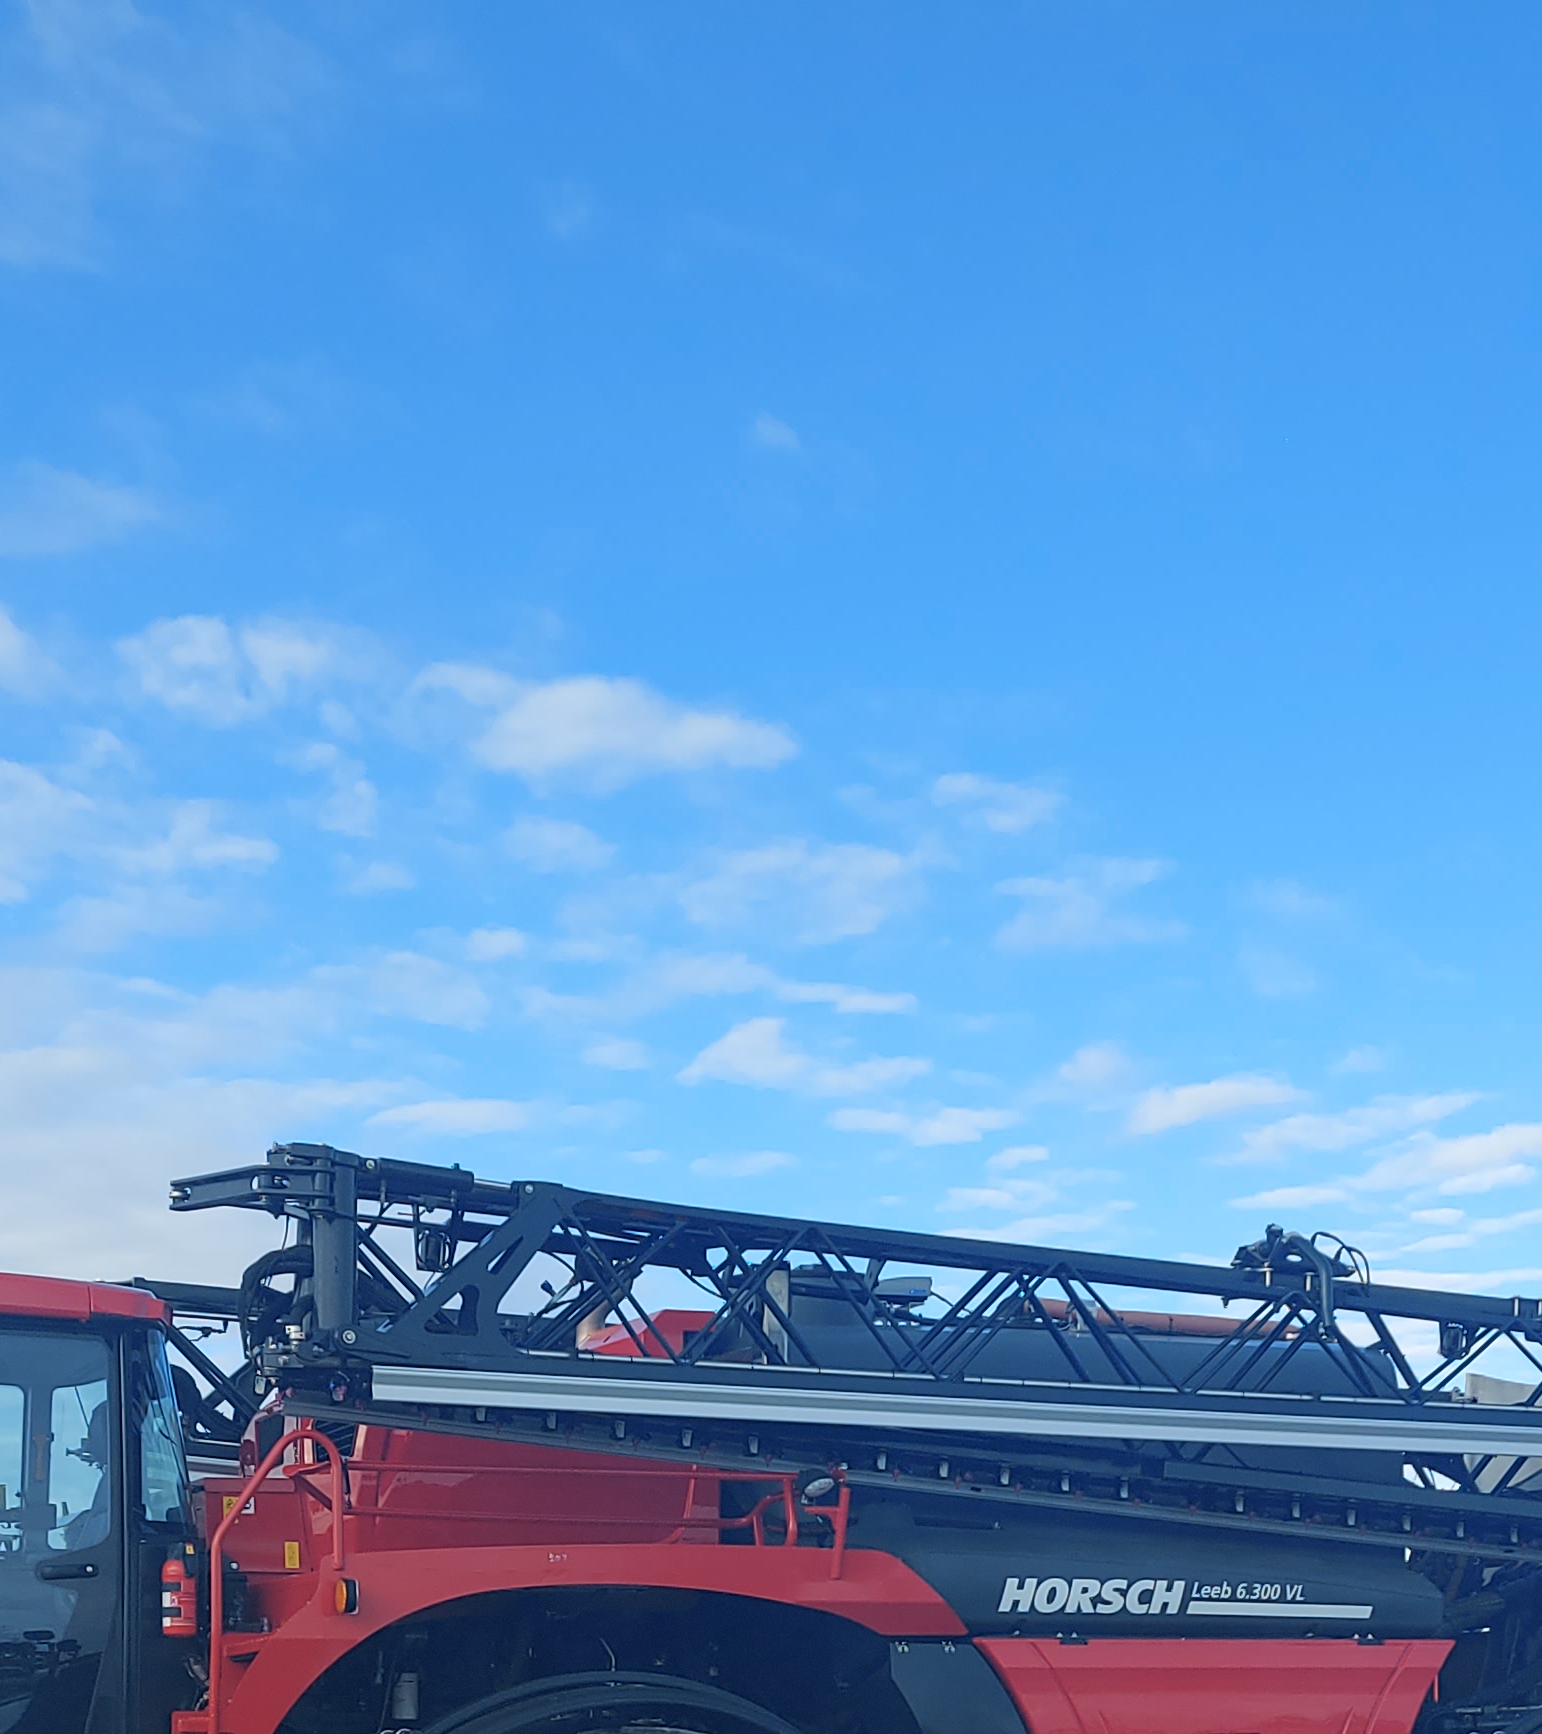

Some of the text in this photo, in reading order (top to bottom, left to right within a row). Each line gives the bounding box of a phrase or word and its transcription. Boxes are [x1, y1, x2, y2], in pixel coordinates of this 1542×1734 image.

[997, 1577, 1305, 1615] HORSCH Leeb 6.300 VL
